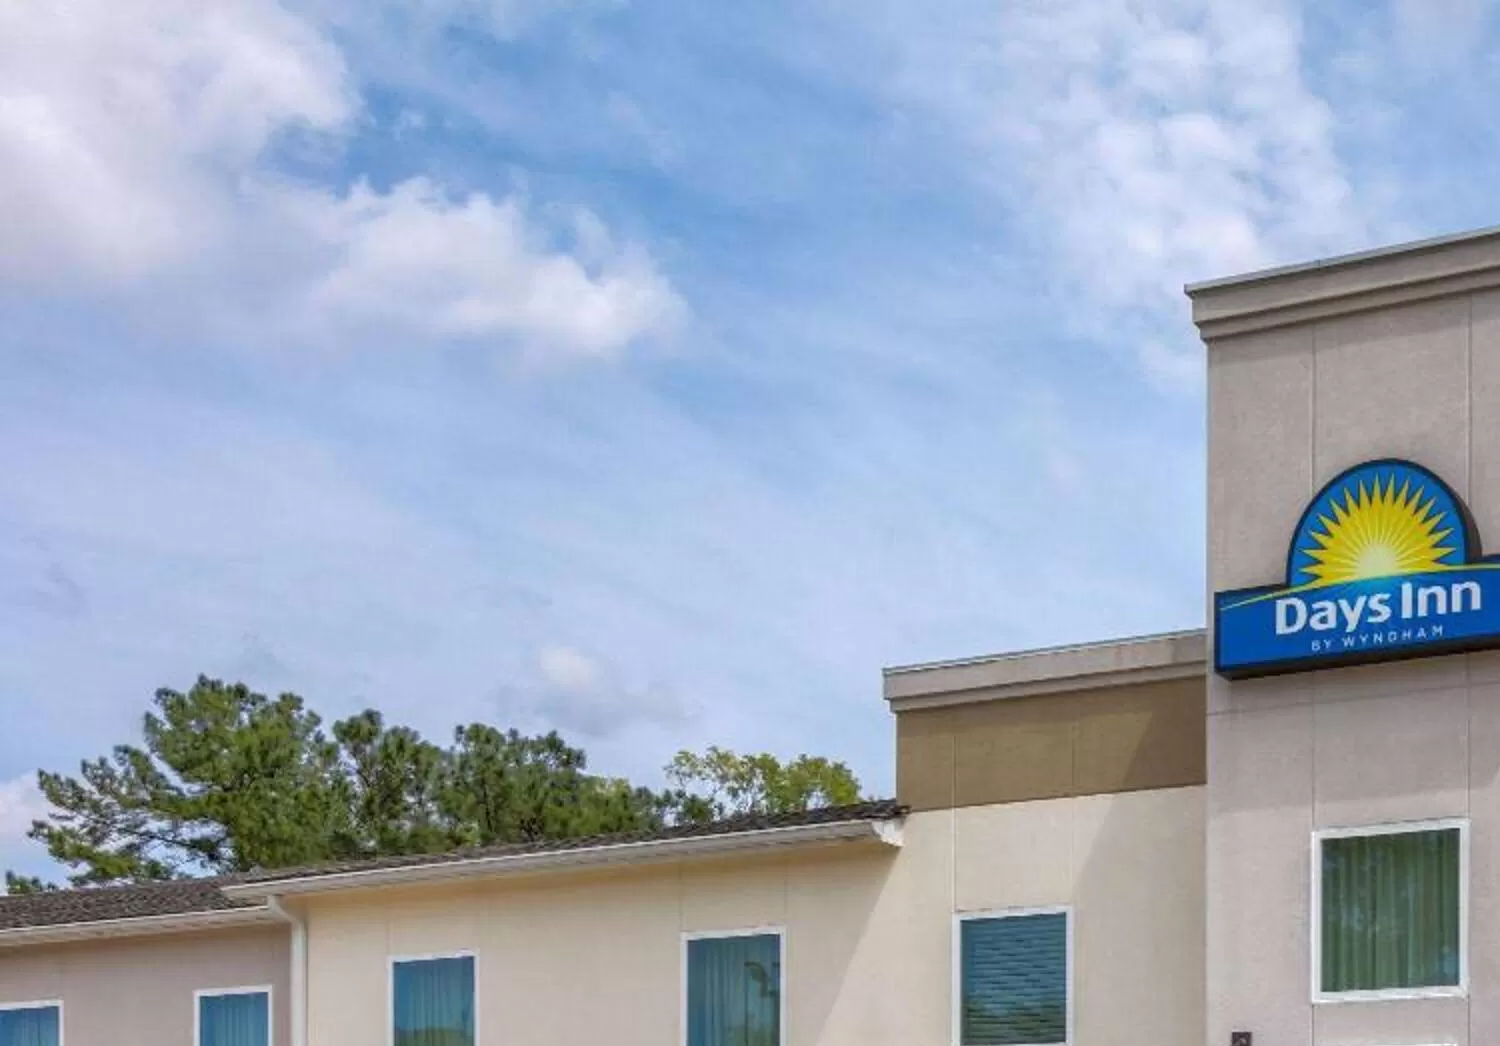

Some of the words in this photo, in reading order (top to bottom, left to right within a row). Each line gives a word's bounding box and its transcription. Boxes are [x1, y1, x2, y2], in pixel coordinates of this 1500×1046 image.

[1275, 592, 1392, 635] Days
[1401, 580, 1481, 619] Inn
[1311, 638, 1334, 651] BY
[1342, 624, 1445, 648] WYNDHAM
